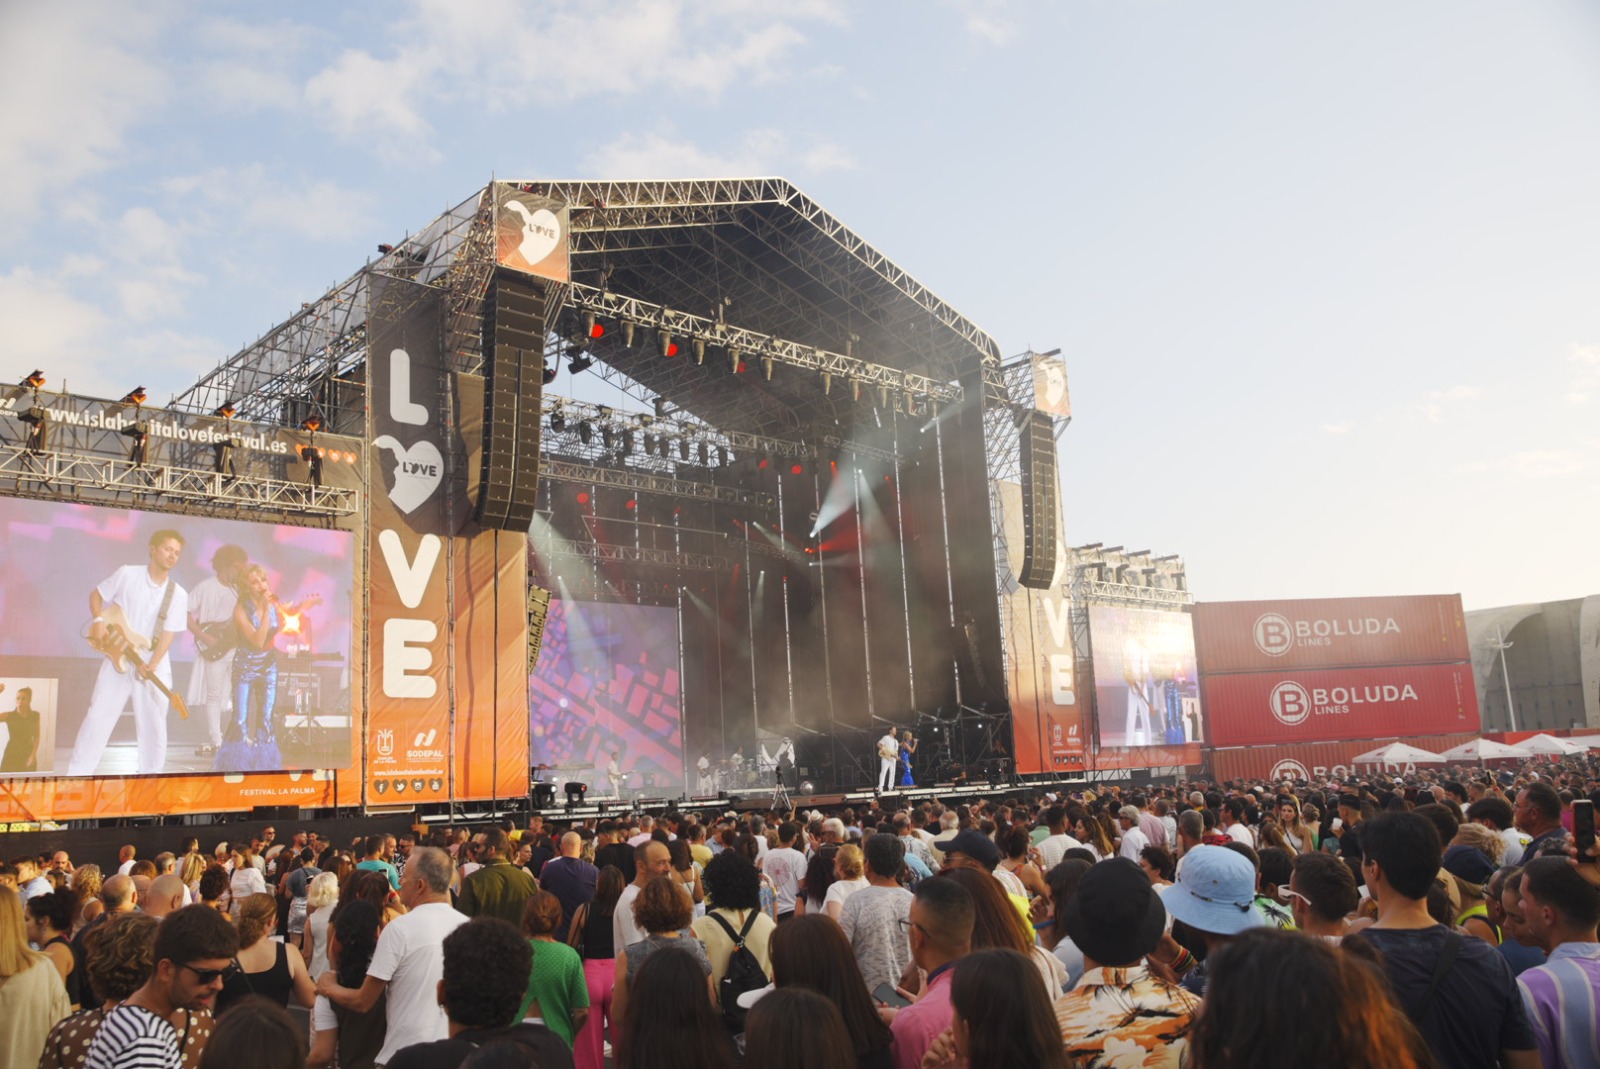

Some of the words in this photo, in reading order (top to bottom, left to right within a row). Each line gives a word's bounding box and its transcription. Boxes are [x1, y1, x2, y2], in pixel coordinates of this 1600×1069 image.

[1295, 617, 1401, 637] BOLUDA
[1298, 637, 1332, 647] LINES
[1312, 684, 1418, 705] BOLUDA
[1315, 704, 1350, 715] LINES
[407, 750, 443, 758] SODEPAL
[239, 788, 276, 796] FESTIVAL
[290, 787, 316, 795] PALMA
